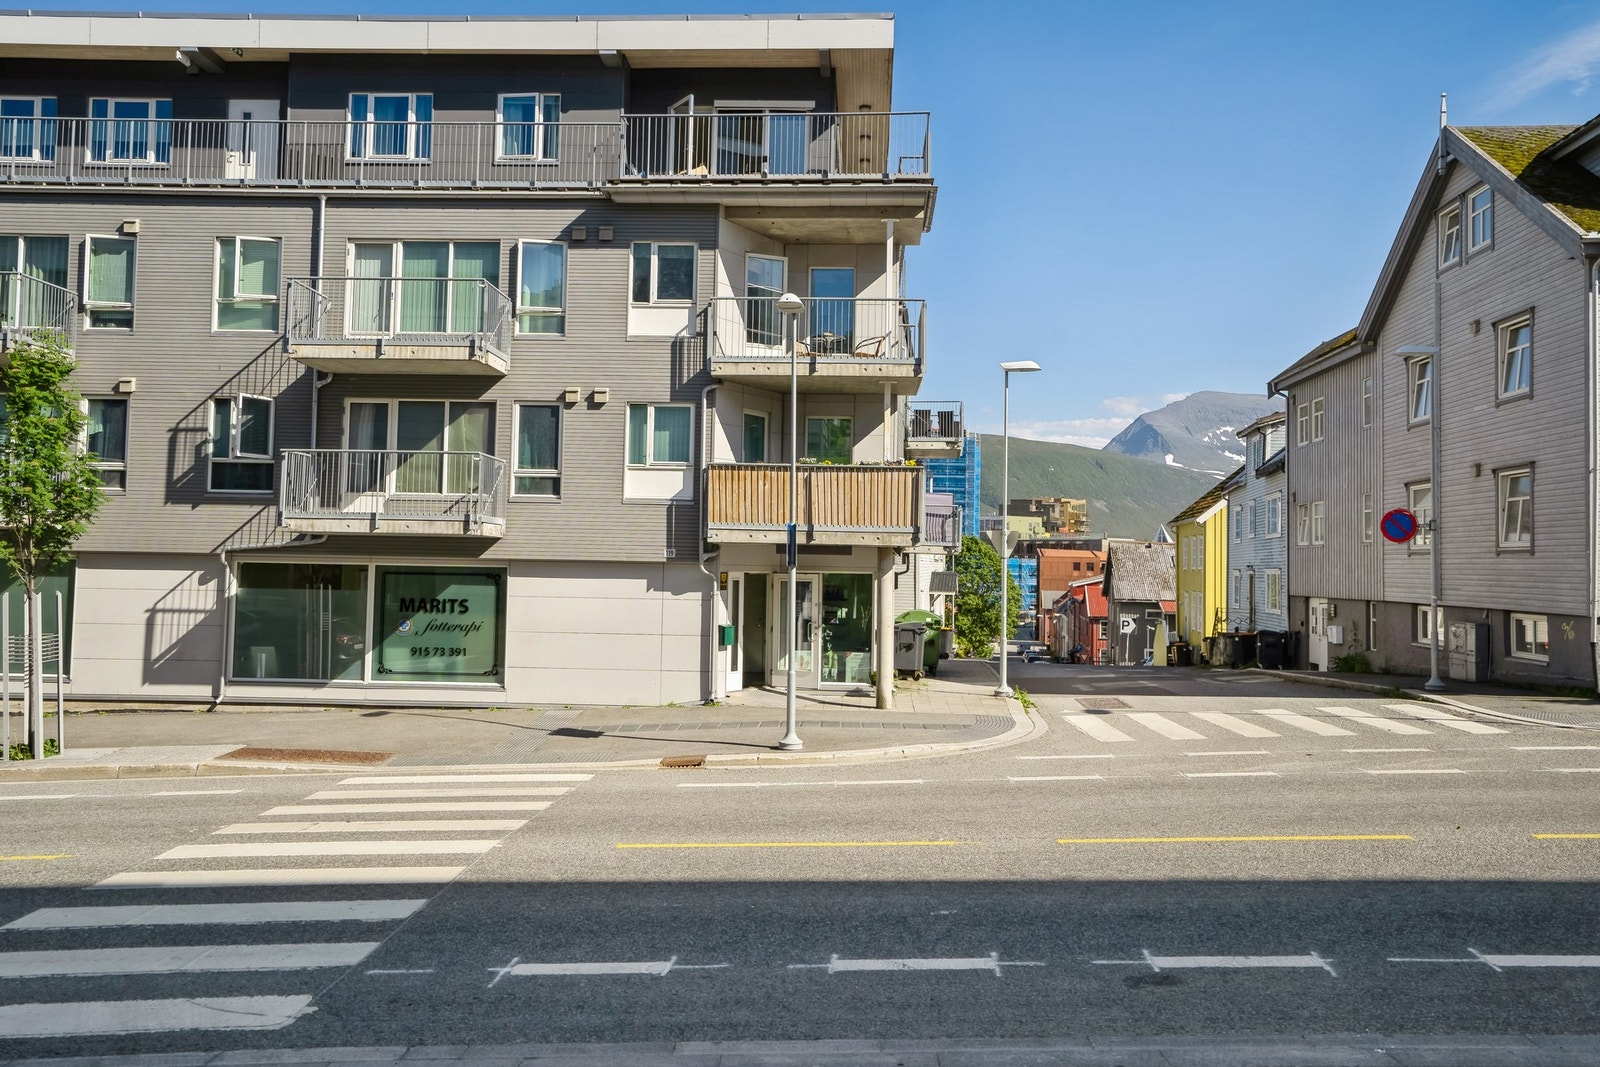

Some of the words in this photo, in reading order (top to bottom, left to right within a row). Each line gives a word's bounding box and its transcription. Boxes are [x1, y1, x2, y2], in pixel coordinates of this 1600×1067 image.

[399, 597, 469, 614] MARITS
[1121, 620, 1130, 630] P
[410, 646, 430, 657] 915
[433, 647, 446, 657] 73
[449, 647, 467, 657] 391
